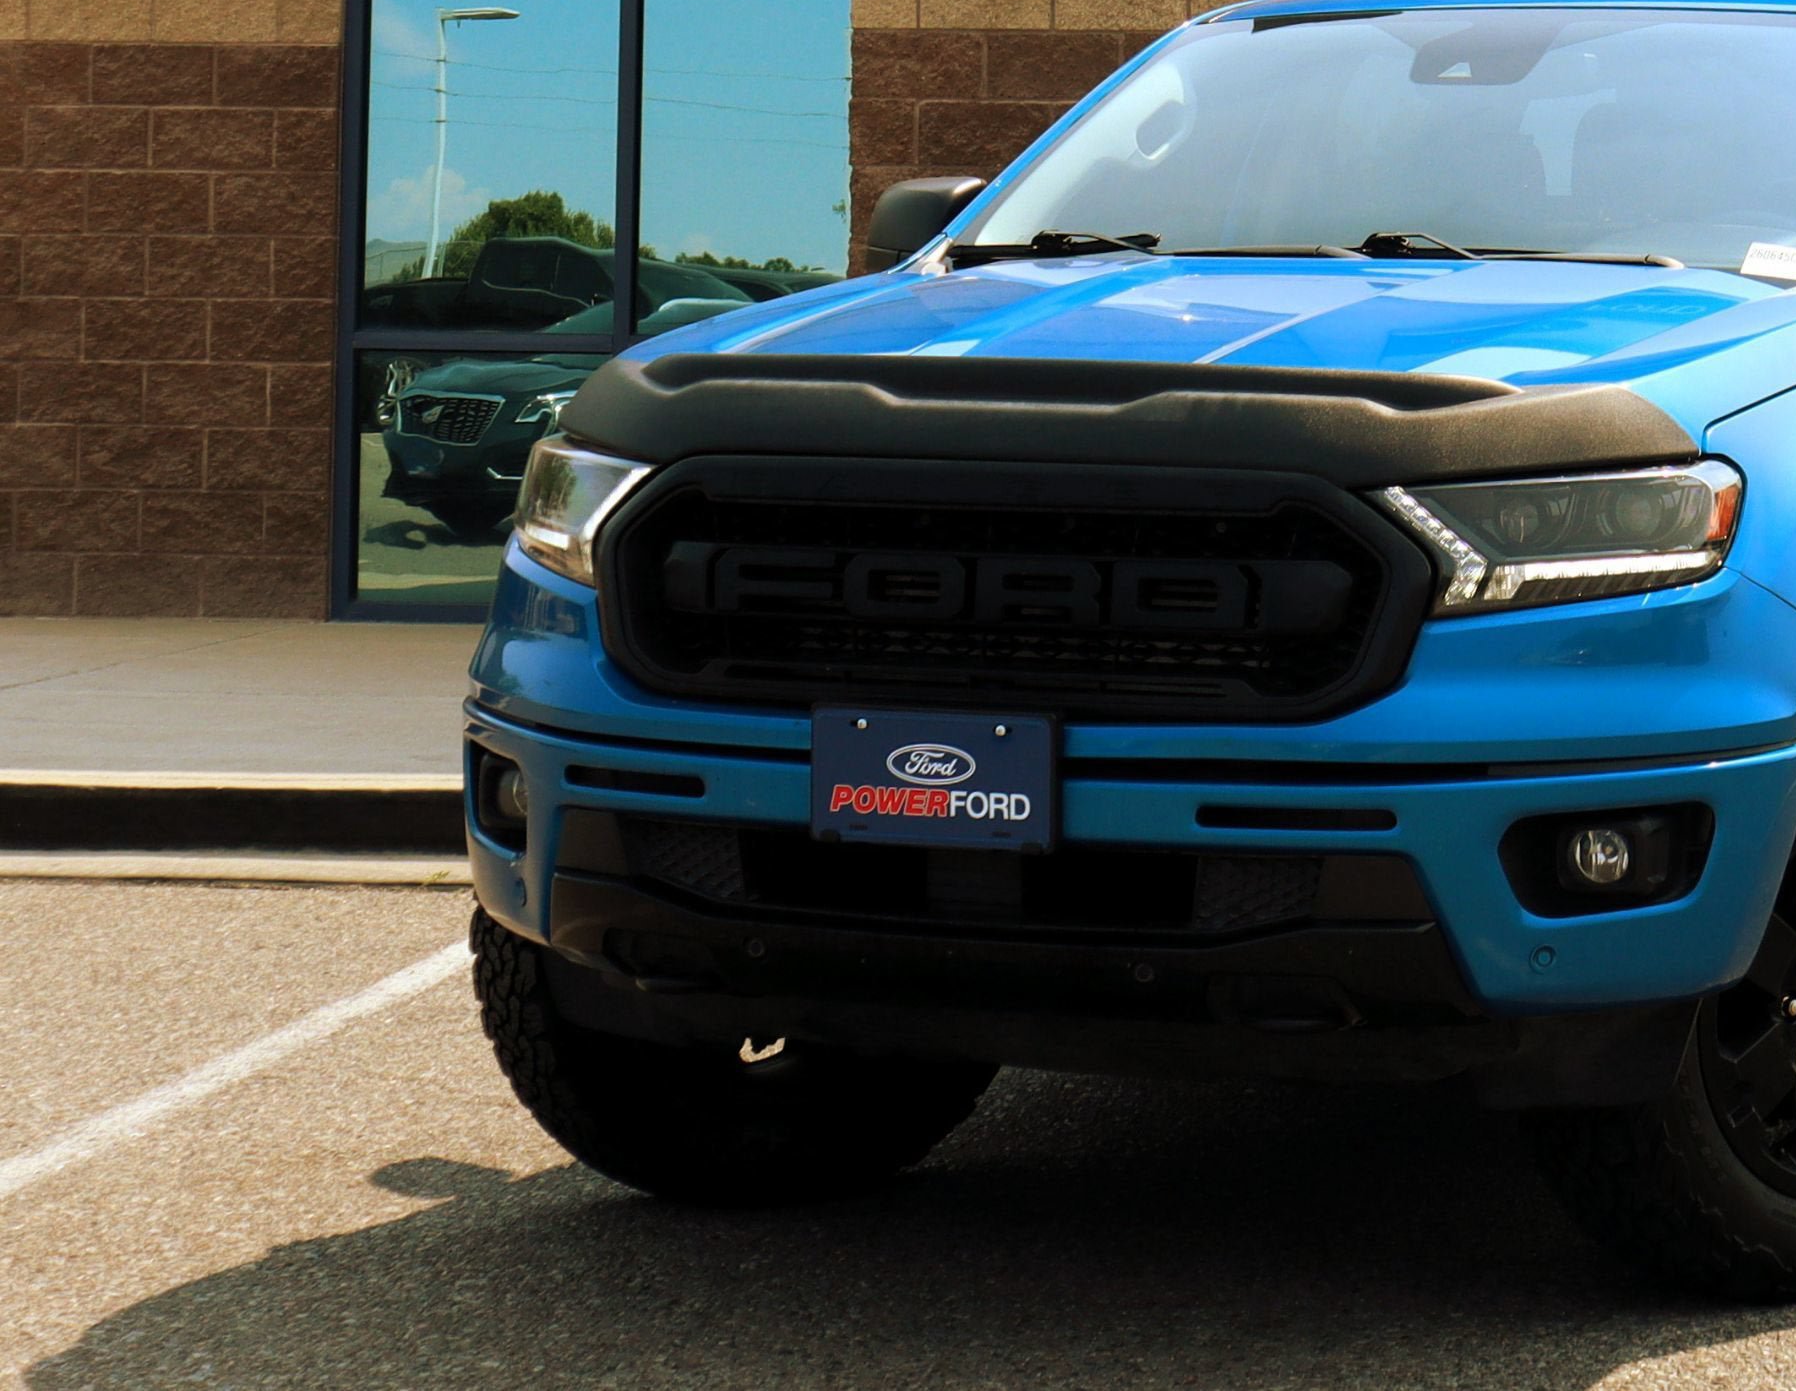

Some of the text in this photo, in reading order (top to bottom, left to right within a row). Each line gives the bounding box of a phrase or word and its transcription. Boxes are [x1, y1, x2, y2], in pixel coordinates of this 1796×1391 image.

[714, 548, 1250, 629] FORD
[905, 751, 957, 776] Ford
[830, 784, 1031, 820] POWERFORD
